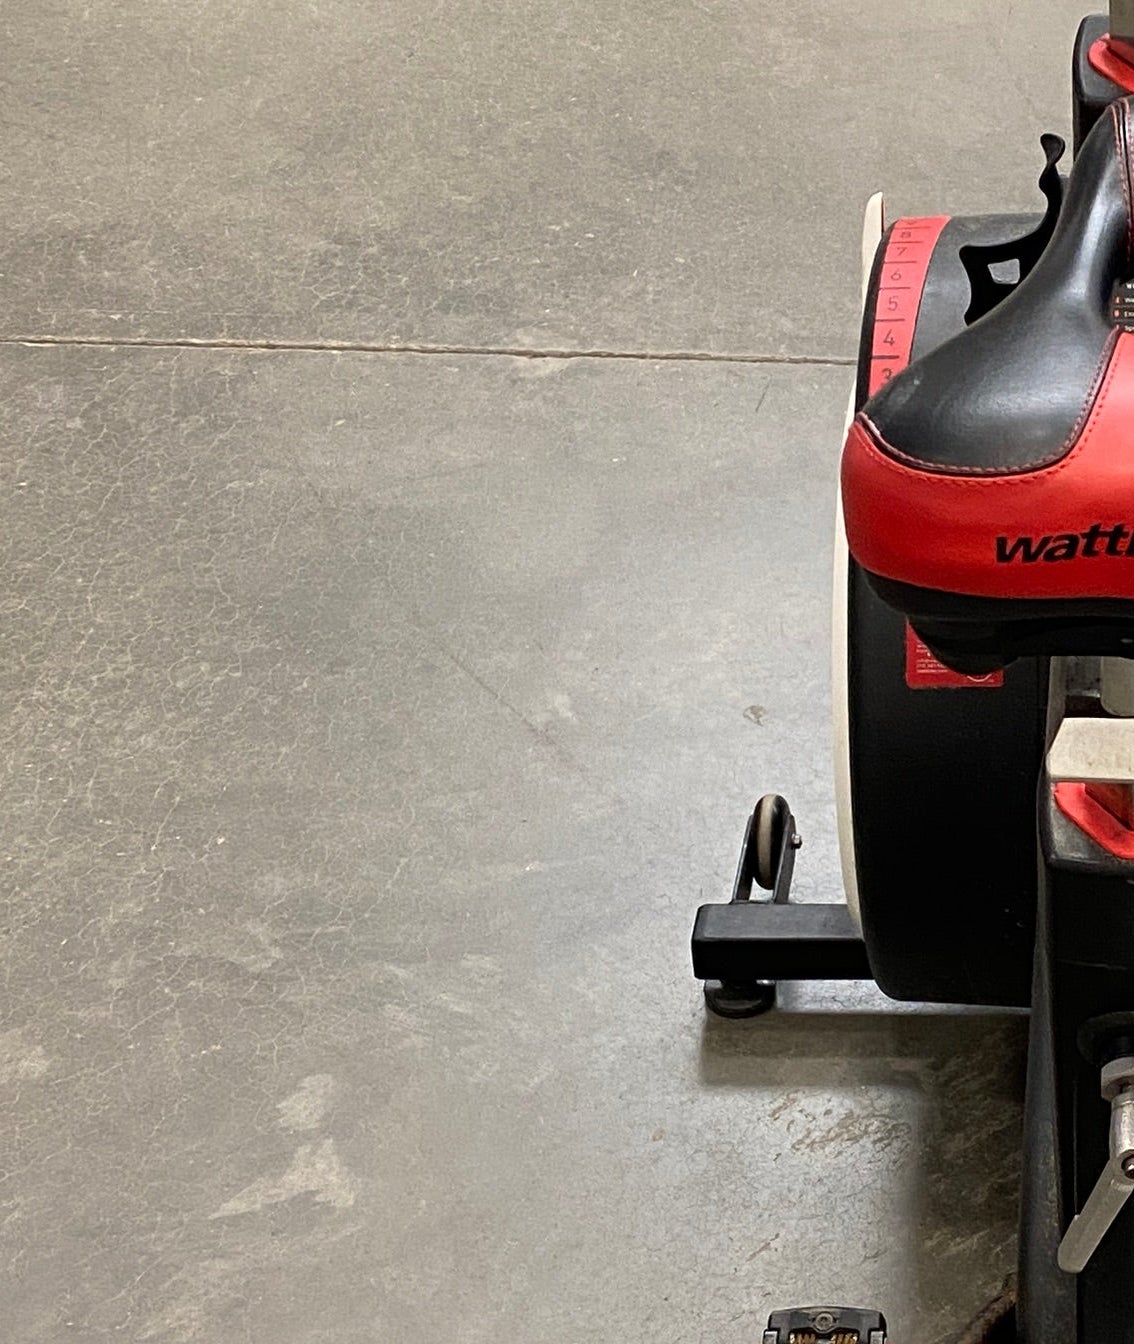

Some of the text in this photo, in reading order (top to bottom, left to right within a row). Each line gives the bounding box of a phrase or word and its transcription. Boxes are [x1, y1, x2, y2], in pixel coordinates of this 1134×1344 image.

[896, 247, 907, 256] 7
[890, 270, 902, 281] 6
[887, 296, 898, 311] 5
[883, 329, 896, 346] 4
